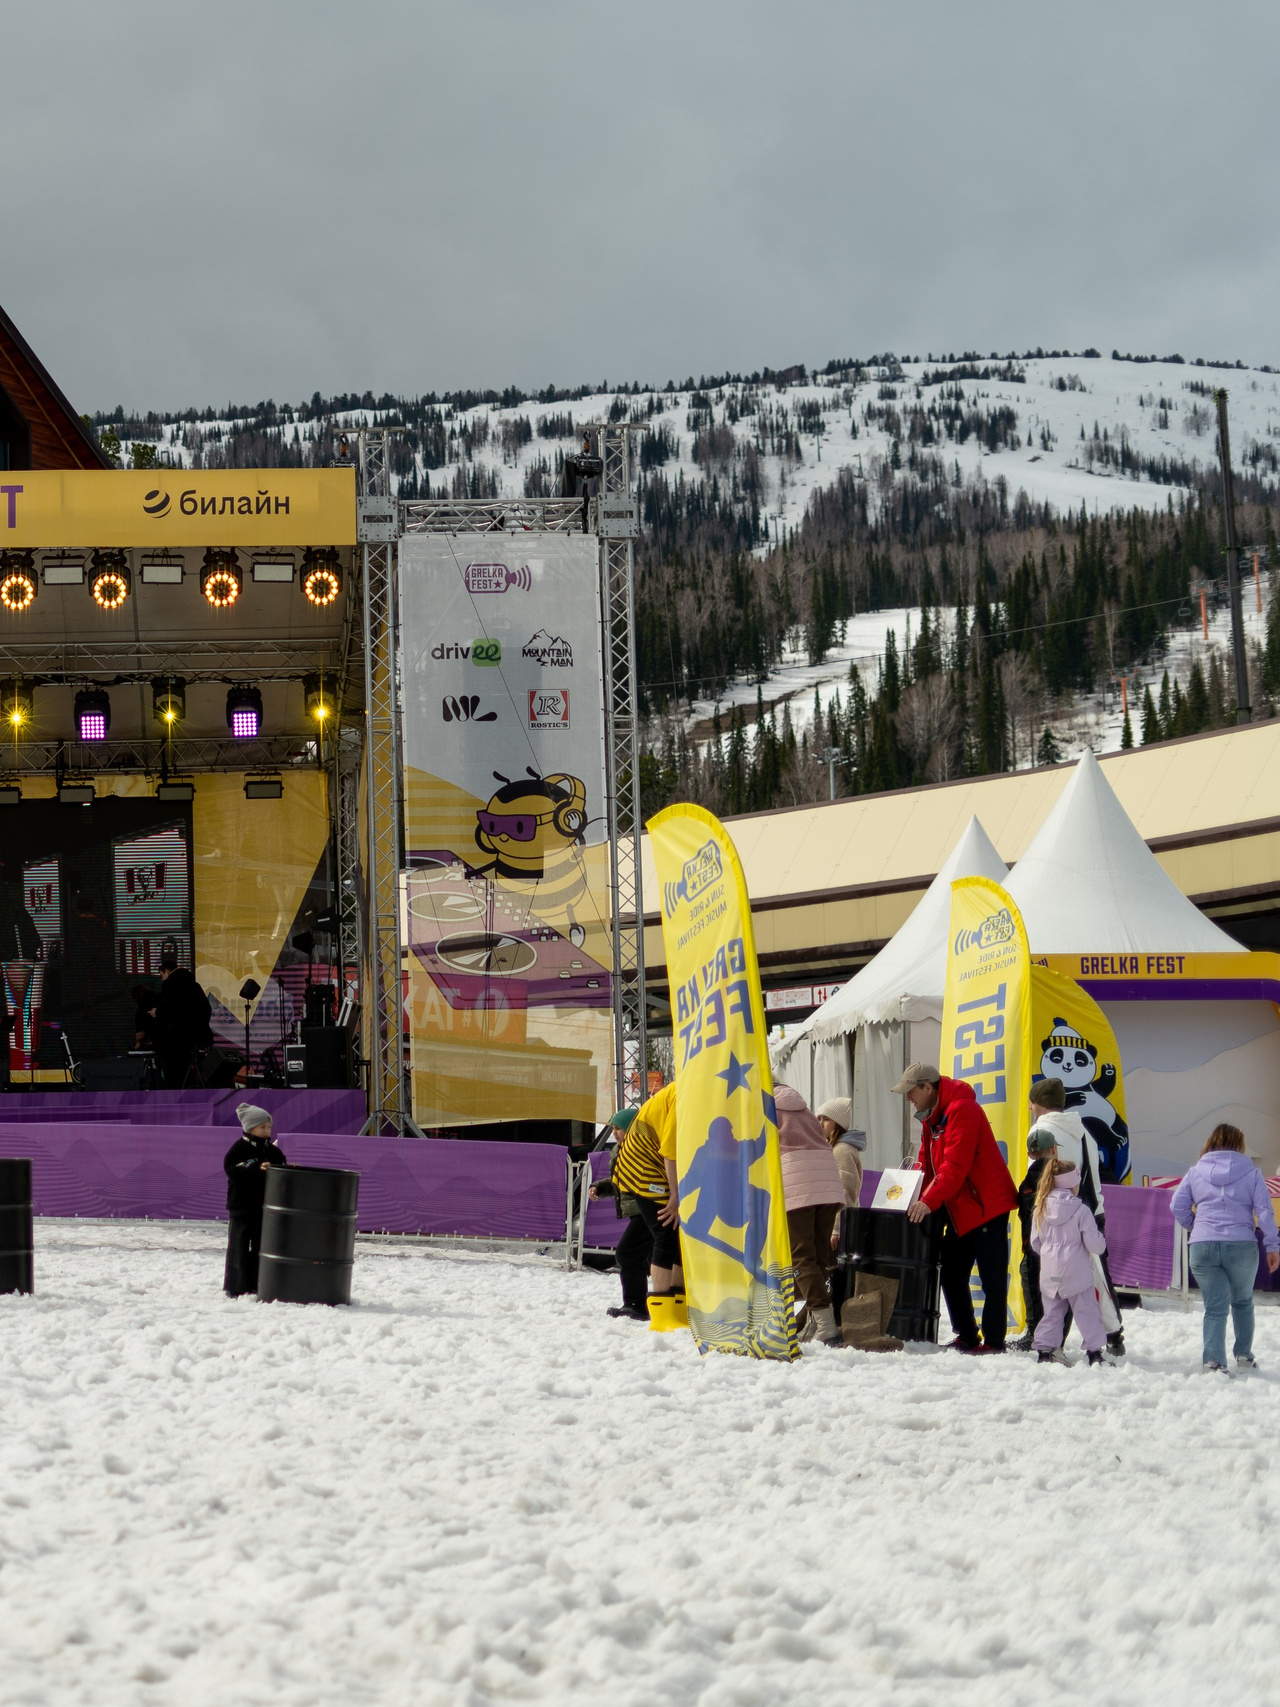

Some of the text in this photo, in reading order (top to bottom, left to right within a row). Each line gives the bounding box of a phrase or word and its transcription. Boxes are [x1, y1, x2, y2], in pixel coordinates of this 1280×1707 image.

[180, 489, 290, 516] билайн
[471, 568, 503, 578] GRELKA
[472, 579, 493, 589] FEST
[431, 643, 501, 661] drivee
[522, 648, 572, 658] MOUNTAIN
[550, 658, 573, 667] MAN
[1081, 956, 1185, 975] GRELKA FEST
